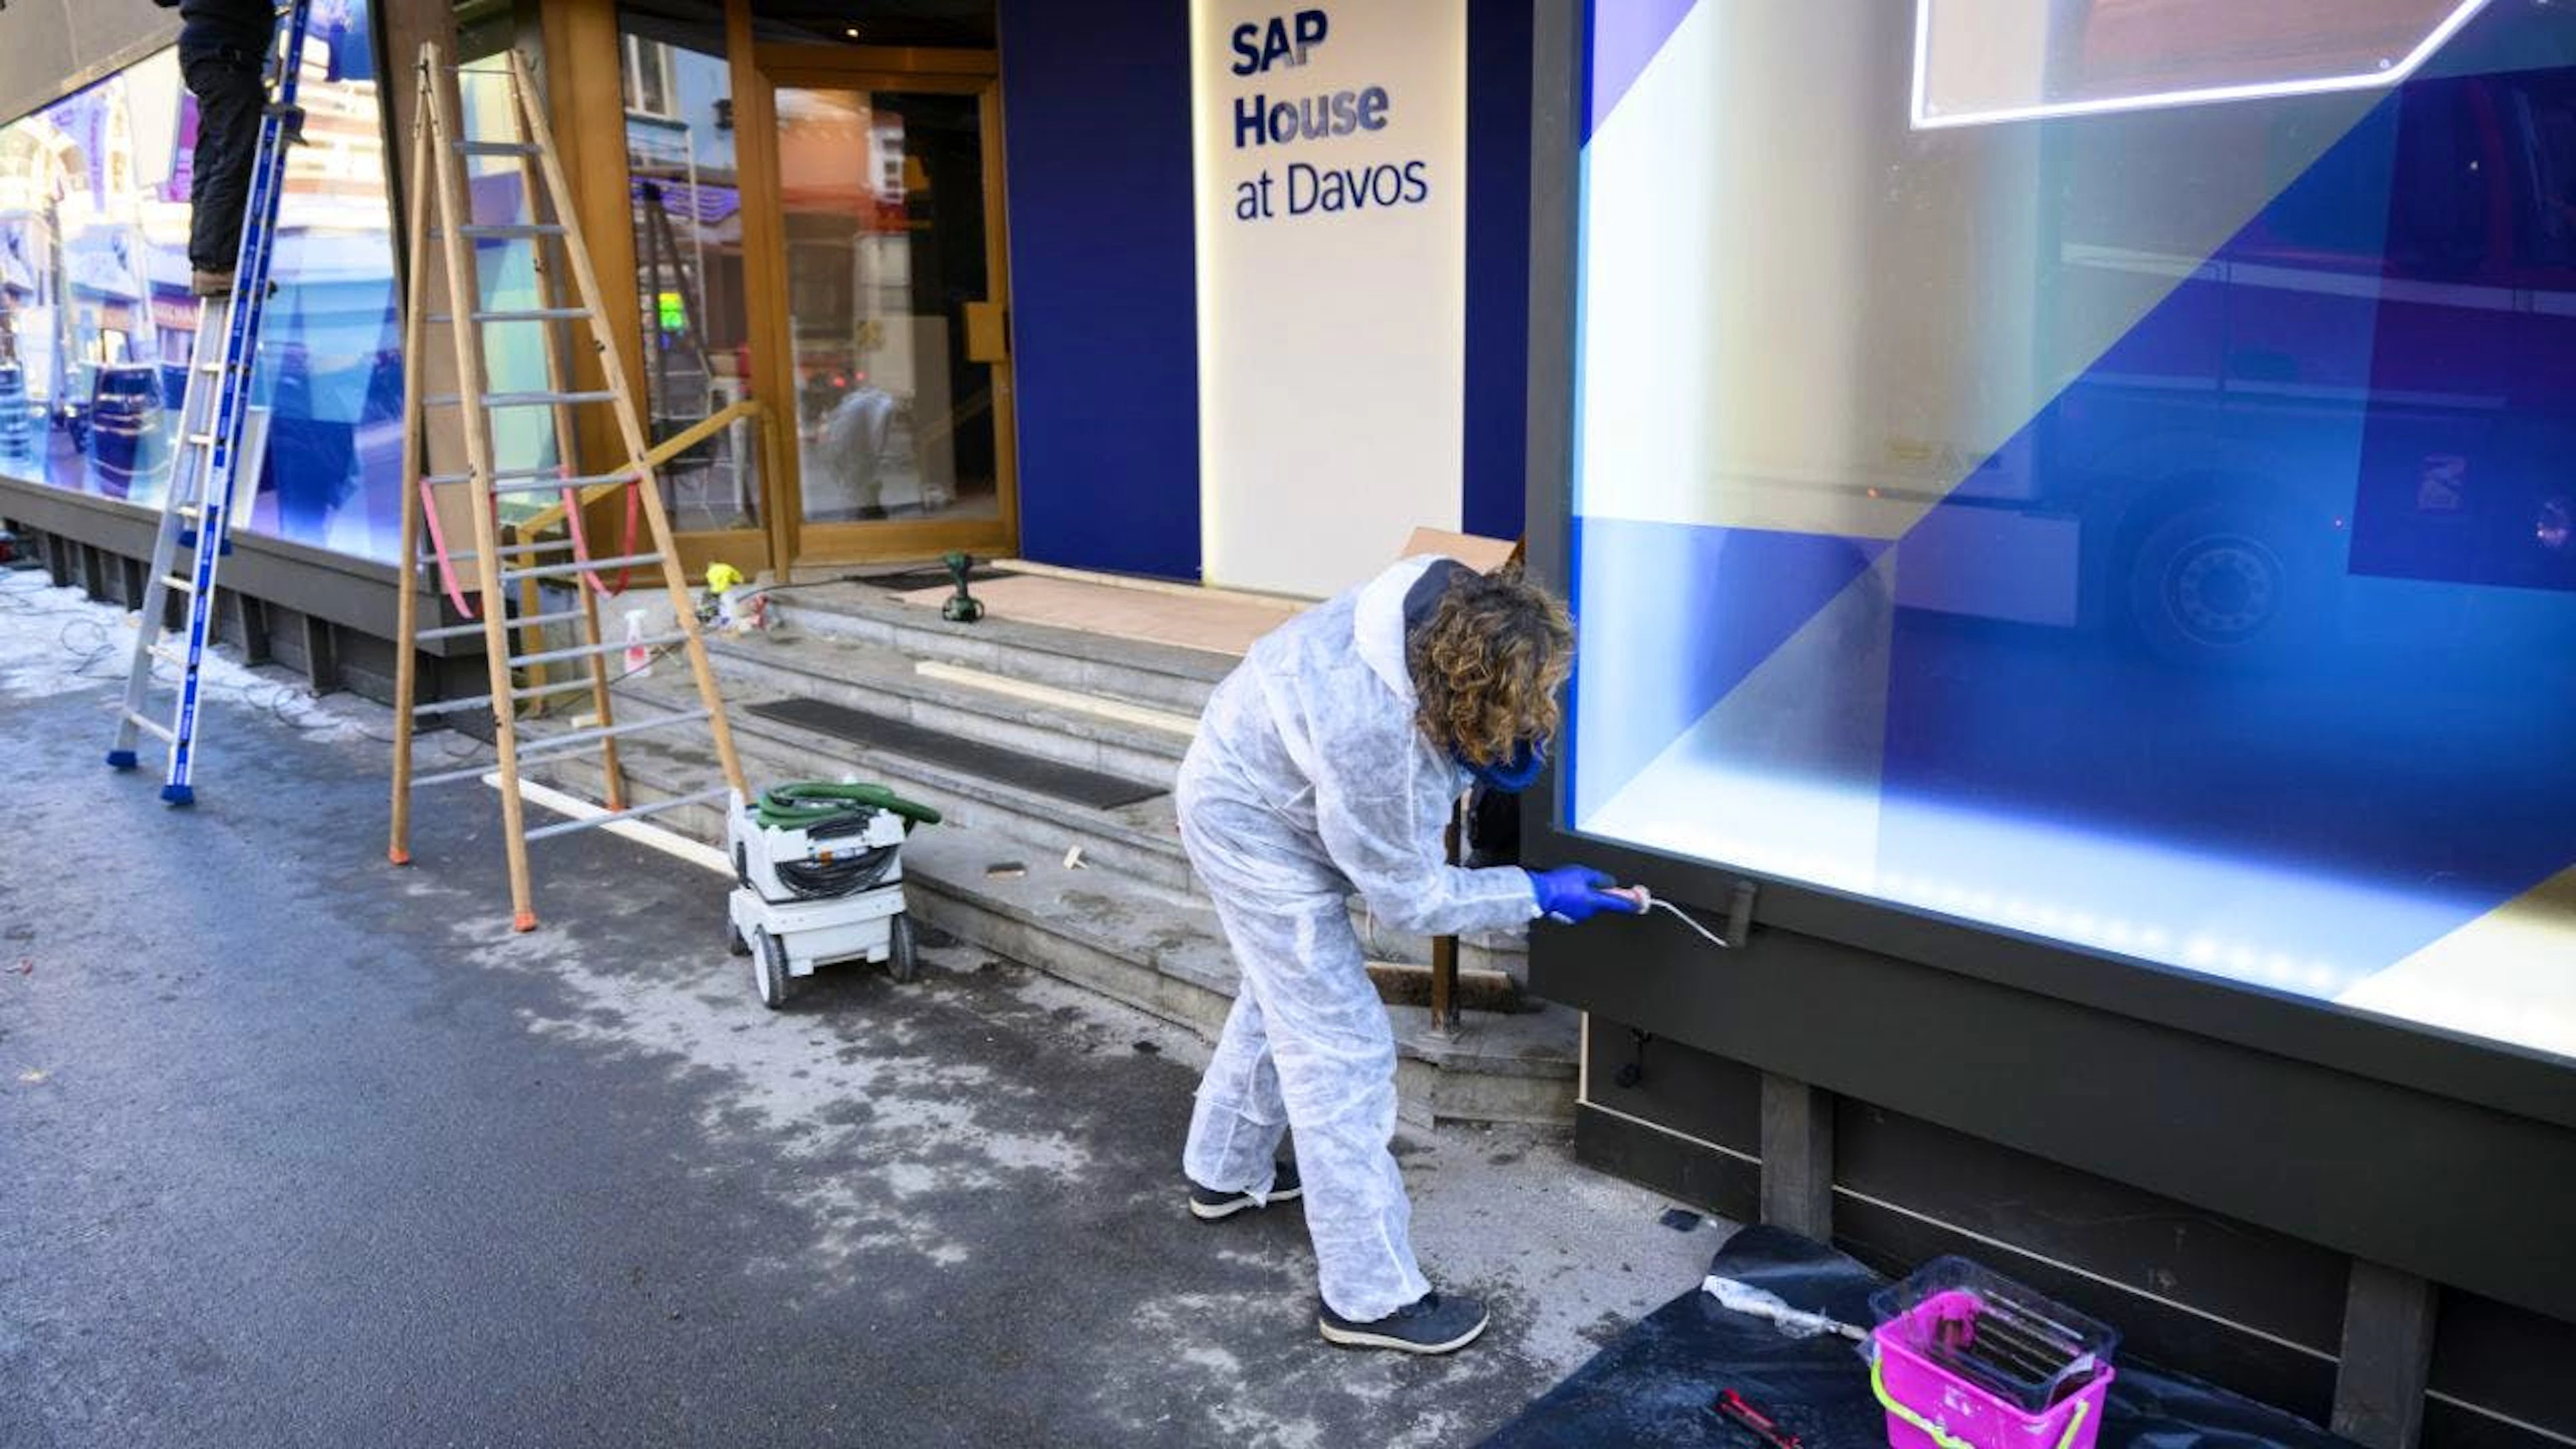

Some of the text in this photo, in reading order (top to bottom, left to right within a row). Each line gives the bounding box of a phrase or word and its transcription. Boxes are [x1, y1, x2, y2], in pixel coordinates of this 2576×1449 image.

[1231, 10, 1328, 76] SAP
[1234, 86, 1389, 148] House
[1236, 161, 1428, 220] at Davos
